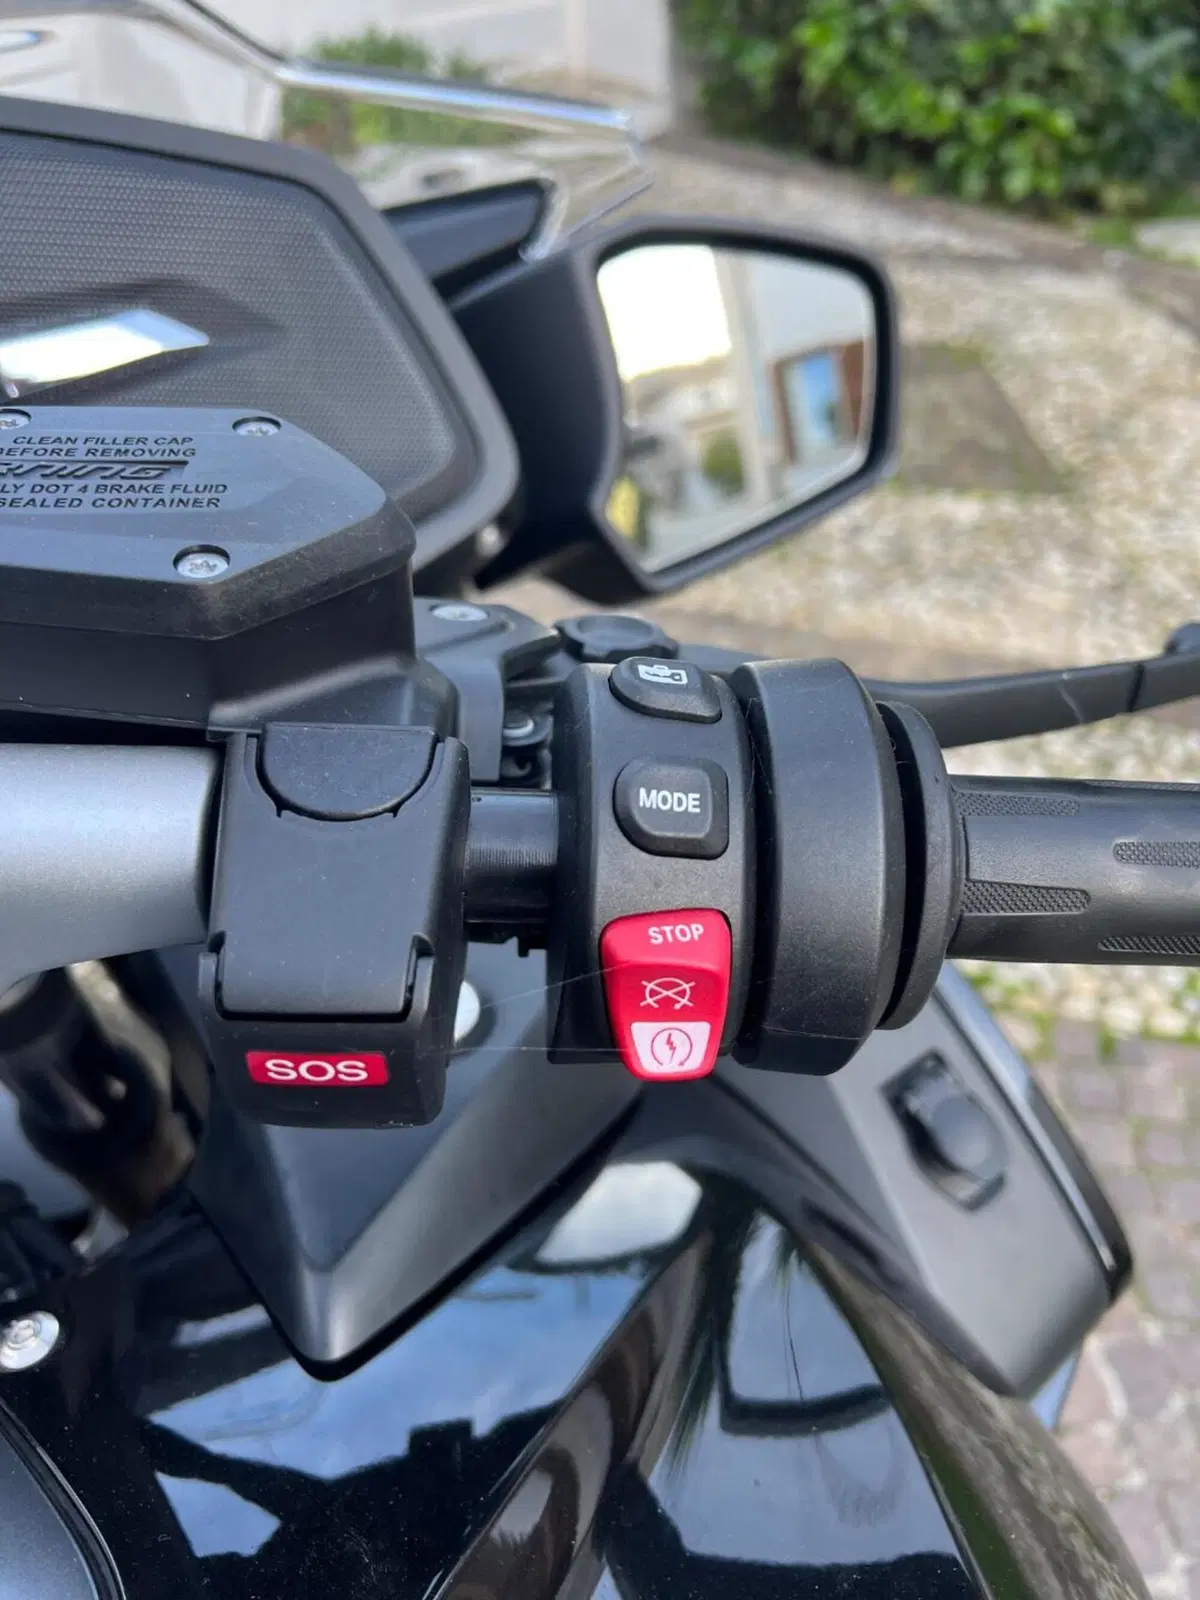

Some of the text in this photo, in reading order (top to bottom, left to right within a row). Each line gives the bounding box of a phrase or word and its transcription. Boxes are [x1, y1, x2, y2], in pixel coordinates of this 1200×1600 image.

[13, 436, 193, 447] CLEAN FILLER CAP
[84, 447, 197, 458] REMOVING
[0, 483, 228, 495] LY DOT 4 BRAKE FLUID
[91, 497, 221, 509] CONTAINER
[638, 786, 701, 813] MODE
[648, 923, 705, 945] STOP
[264, 1058, 369, 1082] SOS
